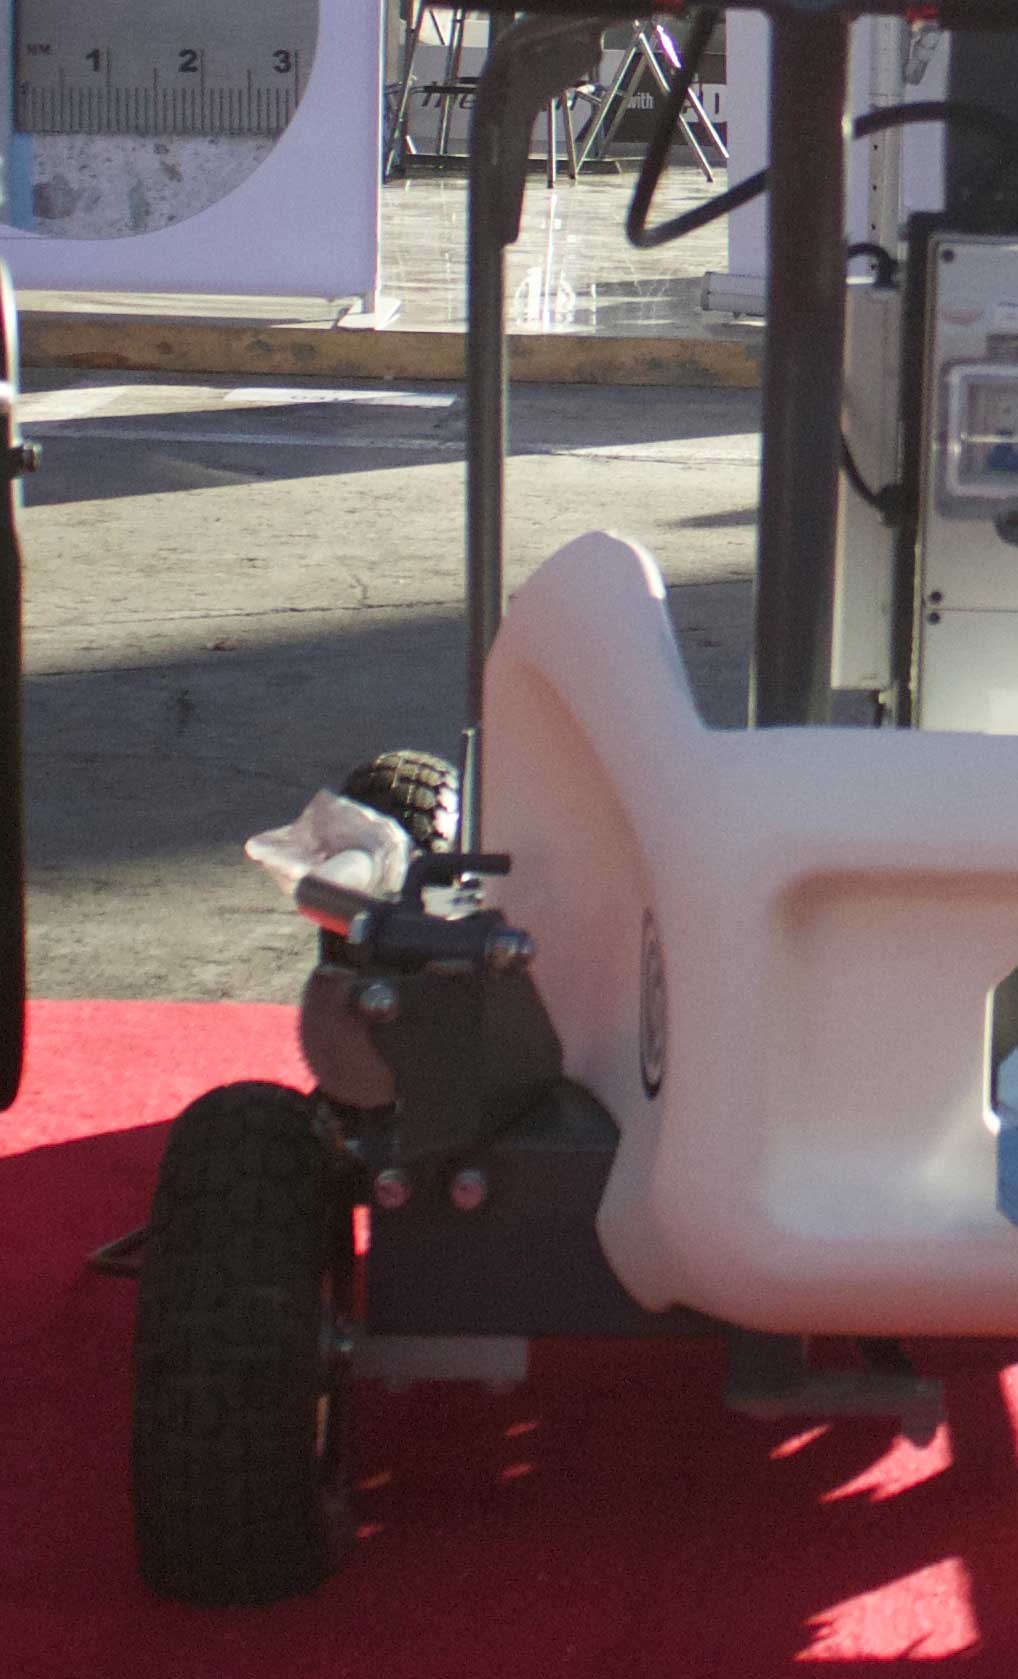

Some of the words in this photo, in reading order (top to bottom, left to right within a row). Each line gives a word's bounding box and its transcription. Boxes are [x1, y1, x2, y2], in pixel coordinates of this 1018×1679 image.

[85, 49, 100, 72] 1
[178, 49, 198, 73] 2
[273, 49, 292, 74] 3
